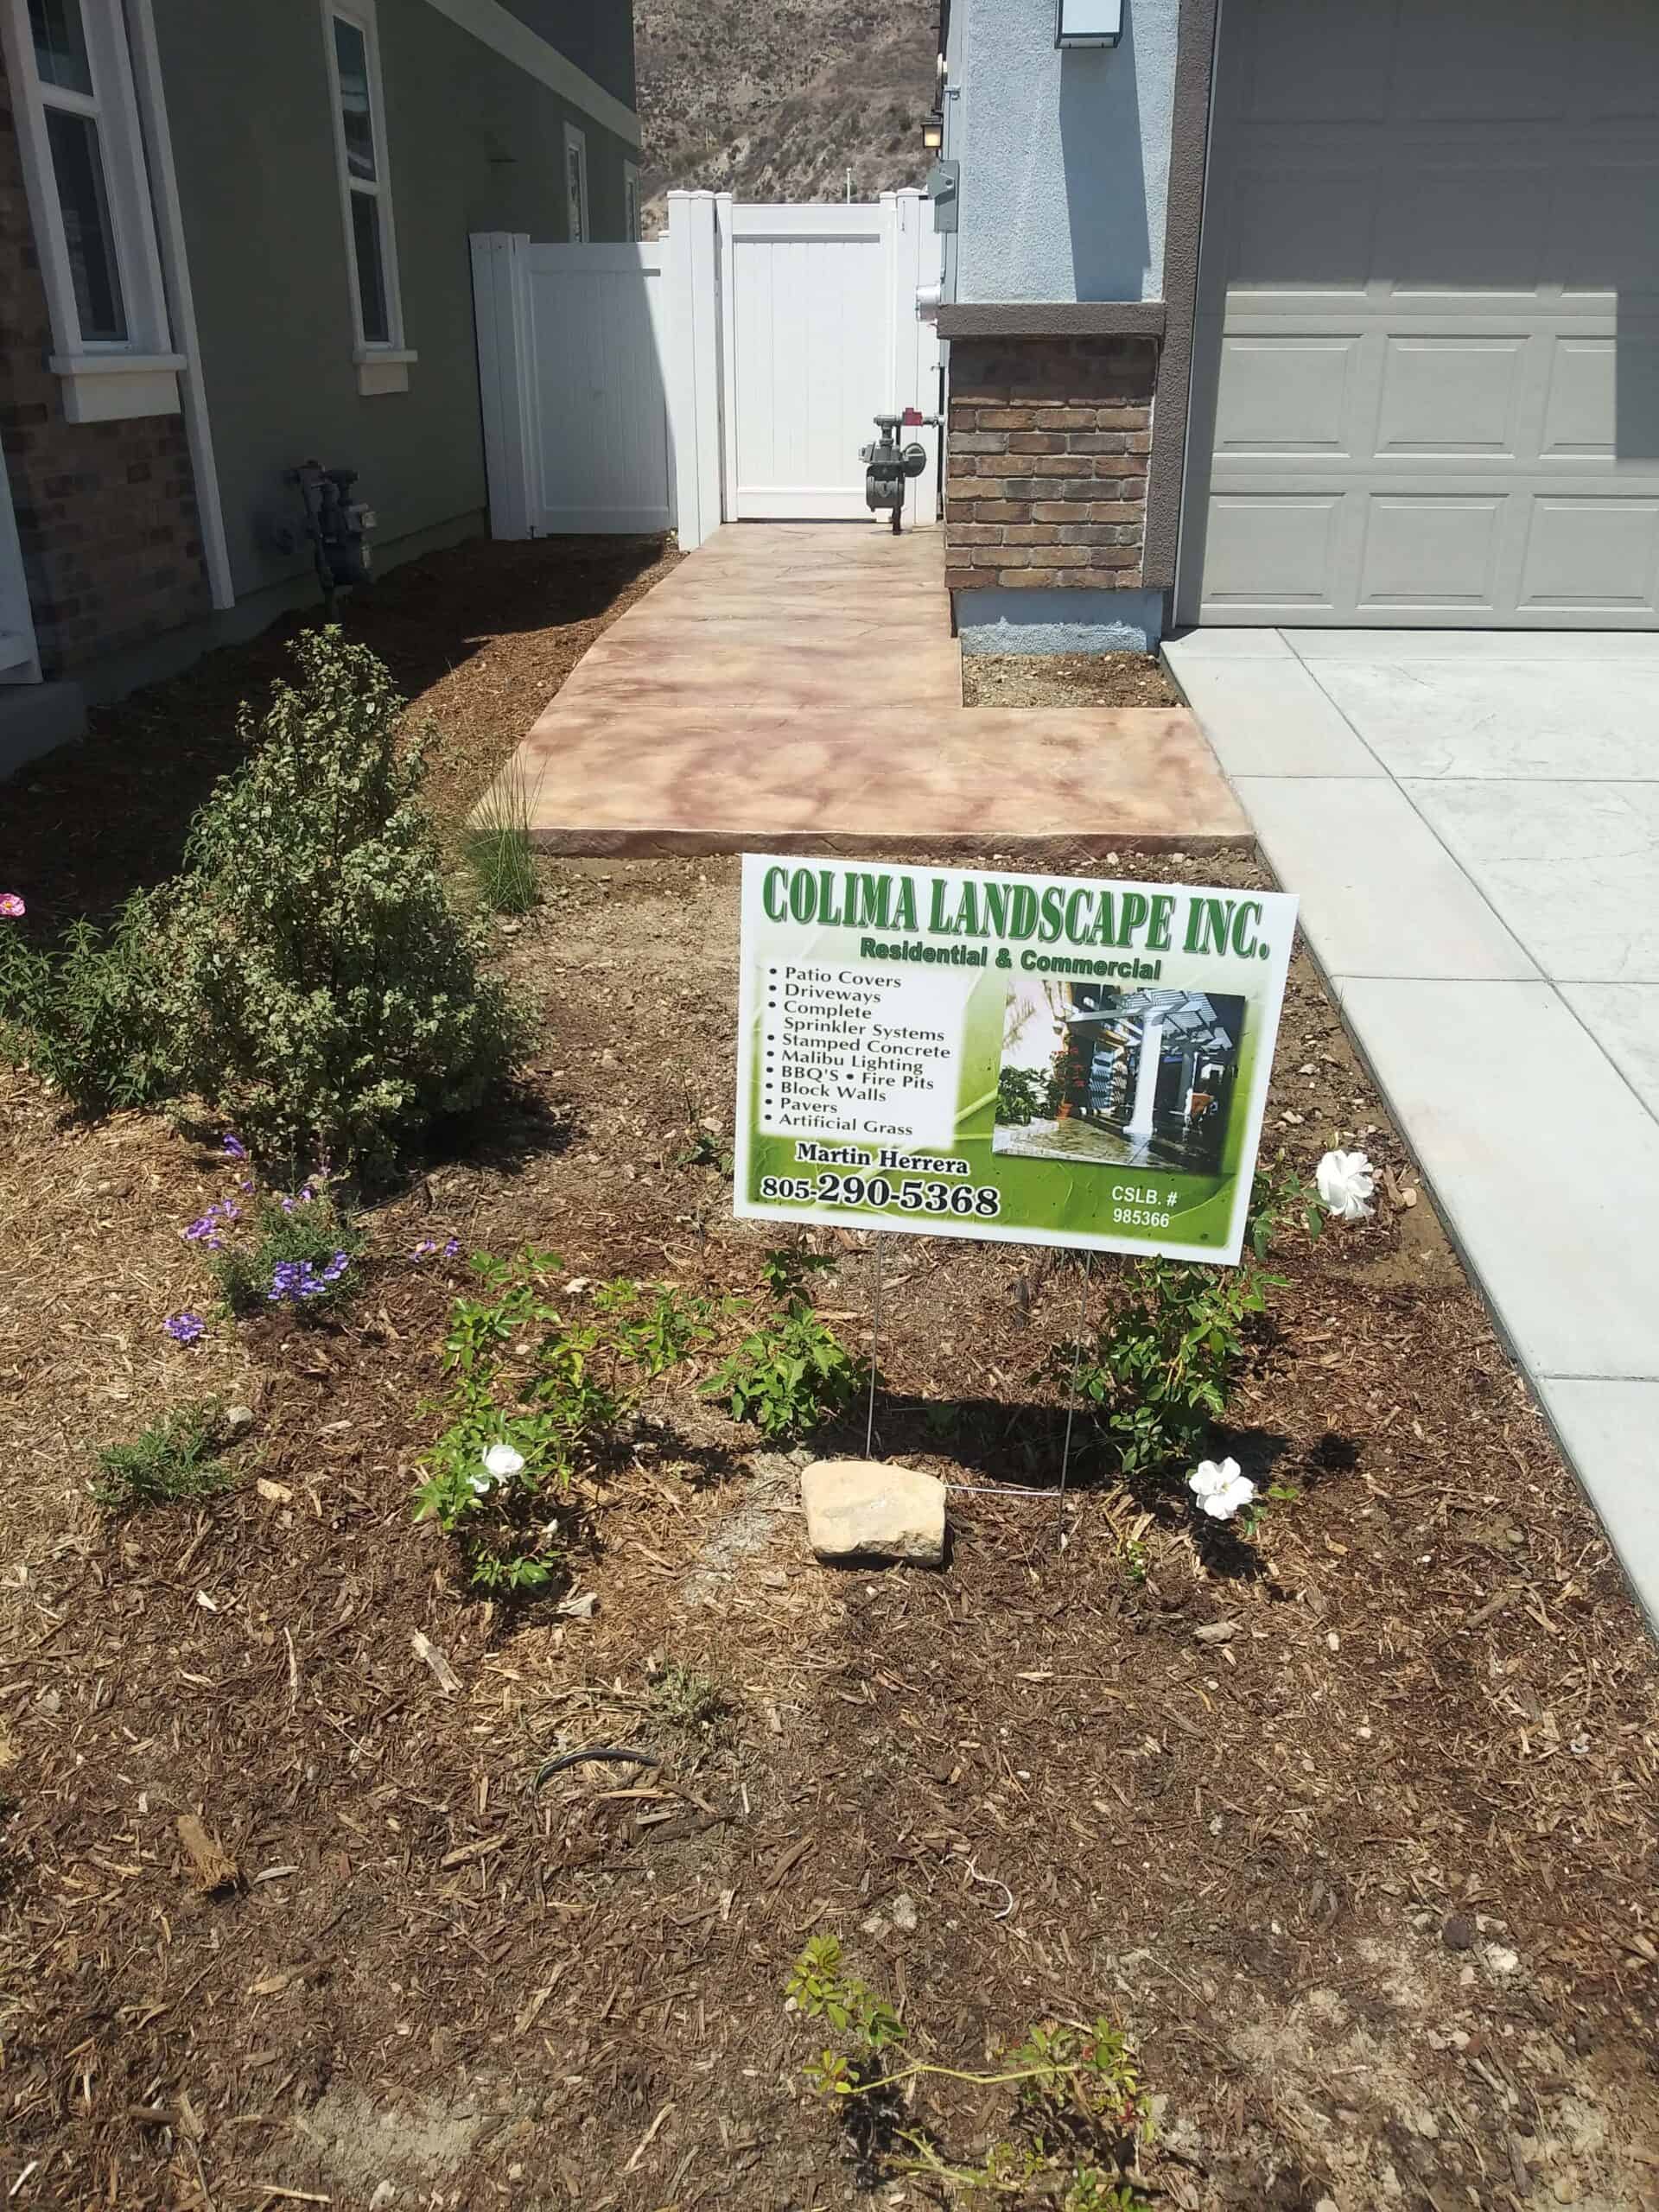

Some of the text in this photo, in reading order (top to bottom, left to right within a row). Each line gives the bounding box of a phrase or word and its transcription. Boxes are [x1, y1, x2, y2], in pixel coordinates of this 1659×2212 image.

[763, 866, 1271, 960] COLIMA LANDSCAPE INC.
[860, 938, 1161, 980] Residential & Commercial
[785, 967, 902, 988] Patio Covers
[785, 983, 882, 1004] Driveways
[784, 1001, 872, 1020] Complete
[784, 1017, 944, 1042] Sprinkler Systems
[782, 1033, 950, 1058] Stamped Concrete
[782, 1049, 924, 1075] Malibu Lighting
[782, 1065, 934, 1090] BBQ'S Fire Pits
[781, 1081, 887, 1102] Block Walls
[780, 1097, 838, 1113] Pavers
[779, 1113, 913, 1135] Artificial Grass
[797, 1143, 969, 1174] Martin Herrera
[762, 1174, 999, 1216] 805-290-5368
[1166, 1191, 1177, 1207] #
[1112, 1208, 1169, 1228] 985366
